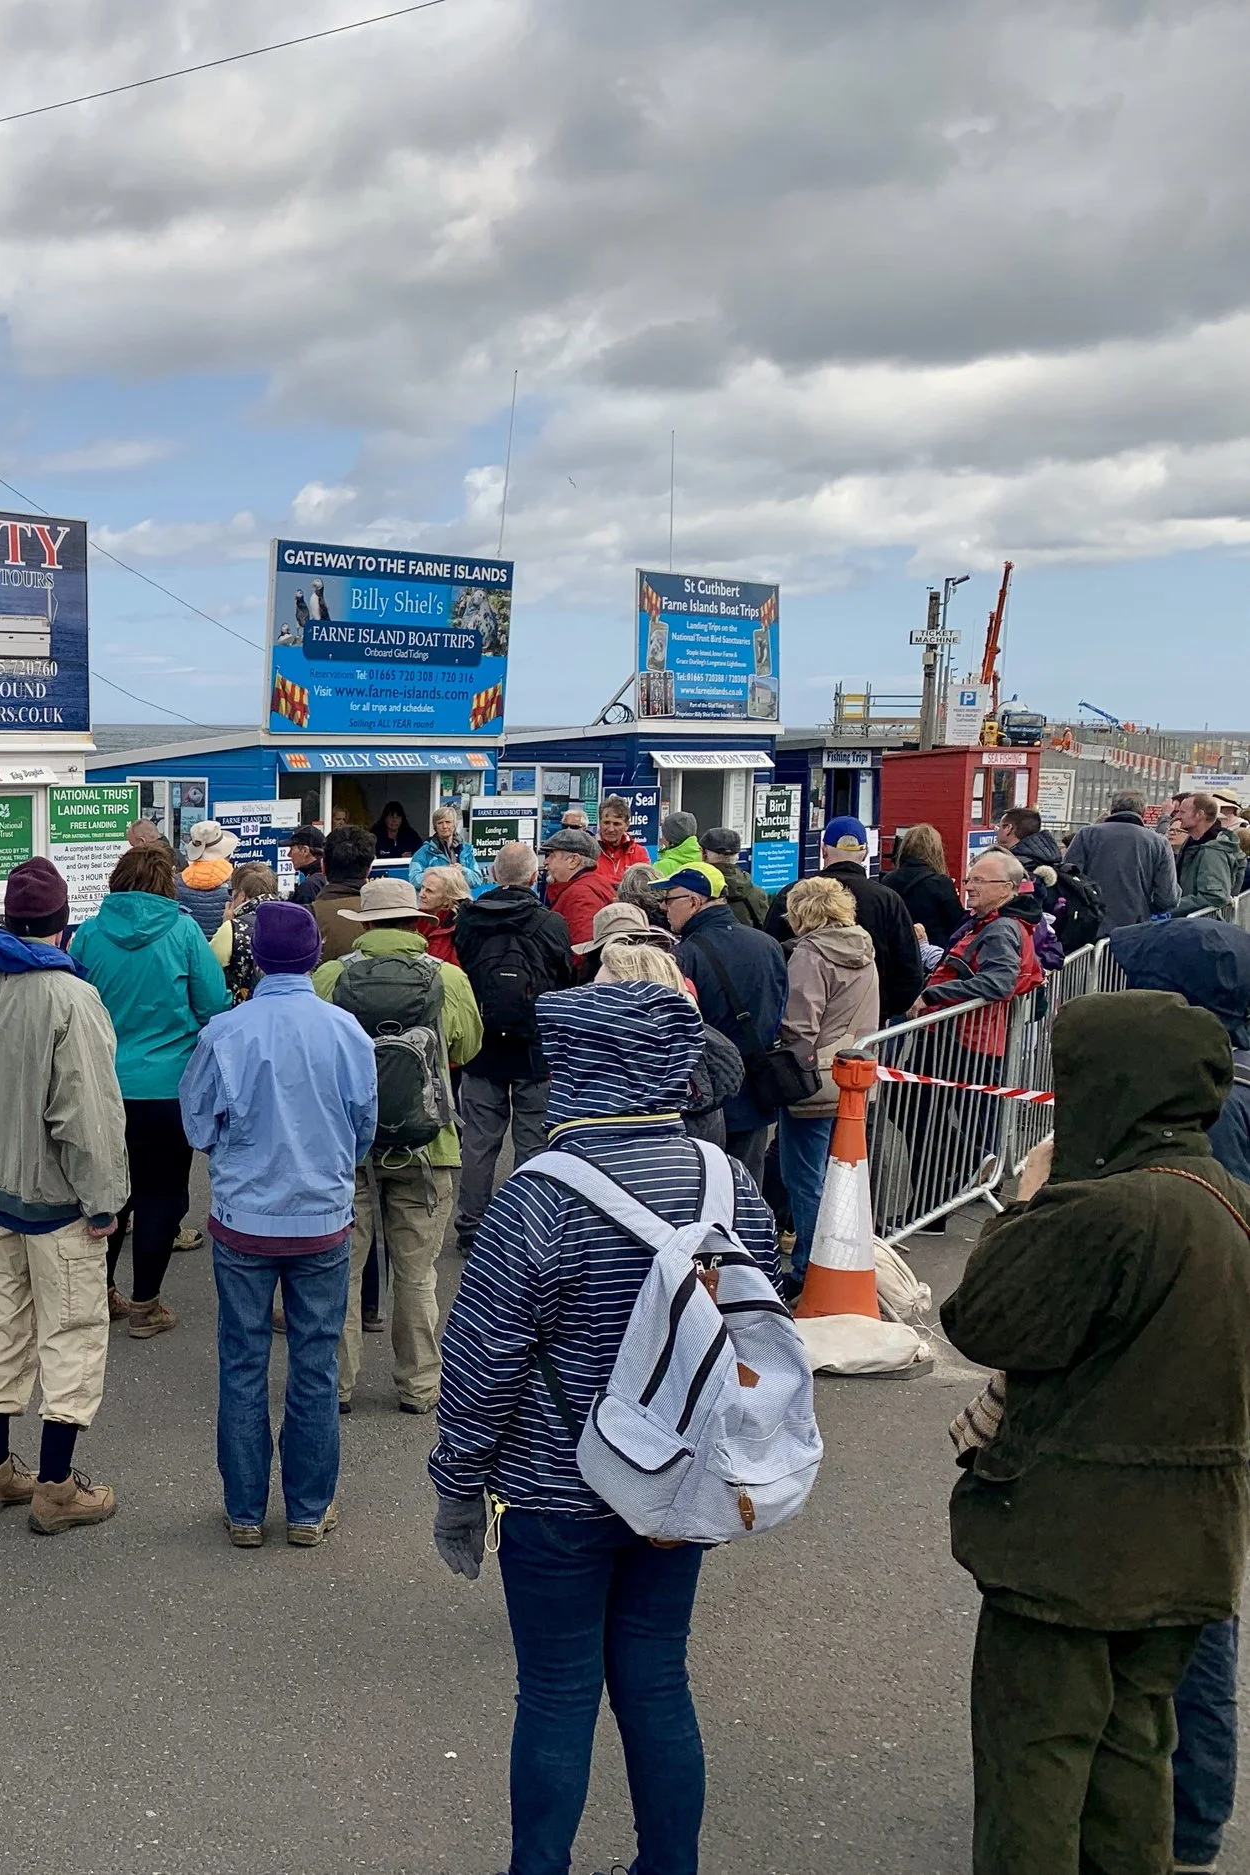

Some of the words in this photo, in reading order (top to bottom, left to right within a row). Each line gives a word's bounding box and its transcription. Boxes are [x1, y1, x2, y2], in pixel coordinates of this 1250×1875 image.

[284, 550, 355, 568] GATEWAY
[357, 556, 377, 571] TO
[378, 558, 405, 573] THE
[408, 561, 450, 578] FARNE
[454, 564, 508, 582] ISLANDS
[0, 568, 54, 589] TOURS
[684, 578, 695, 593] St
[698, 580, 740, 598] Cuthbert
[351, 588, 389, 617] Billy
[395, 591, 443, 615] Shiel's
[662, 597, 688, 611] Farne
[689, 599, 718, 614] Islands
[720, 602, 739, 616] Boat
[740, 604, 759, 620] Trips
[312, 626, 355, 643] FARNE
[358, 628, 405, 645] ISLAND
[408, 631, 441, 647] BOAT
[443, 633, 475, 648] TRIPS
[710, 634, 721, 643] Bird
[365, 647, 393, 658] Onboard
[394, 648, 408, 658] Glad
[408, 649, 429, 661] Tidings
[10, 659, 58, 677] 720760
[368, 669, 396, 681] 01665
[399, 670, 415, 681] 720
[418, 671, 433, 682] 308
[441, 672, 456, 683] 720
[459, 672, 474, 683] 316
[313, 685, 332, 697] Visit
[335, 684, 469, 701] www.farne-islands.com
[963, 692, 974, 705] P
[350, 701, 360, 711] for
[362, 702, 370, 711] all
[372, 702, 387, 713] trips
[388, 702, 401, 712] and
[377, 719, 391, 728] ALL
[393, 719, 411, 728] YEAR
[413, 719, 434, 728] round
[319, 753, 374, 767] BILLY
[375, 753, 429, 767] SHIEL
[674, 754, 717, 764] CUTHBERT
[717, 754, 741, 764] BOAT
[740, 754, 766, 764] TRIPS
[827, 751, 850, 765] Fishing
[852, 751, 868, 765] Trips
[987, 753, 999, 763] SEA
[999, 753, 1022, 764] FISHING
[24, 768, 44, 780] Douglas
[53, 790, 101, 801] NATIONAL
[102, 789, 134, 800] TRUST
[635, 792, 656, 806] Seal
[57, 805, 100, 816] LANDING
[102, 803, 130, 815] TRIPS
[769, 799, 787, 813] Bird
[0, 820, 23, 830] National
[70, 821, 87, 830] FREE
[88, 820, 117, 830] LANDING
[222, 816, 240, 825] FARNE
[0, 829, 14, 838] Trust
[242, 824, 259, 834] 10-30
[761, 830, 781, 840] Landing
[237, 838, 252, 847] Seal
[253, 837, 277, 846] Cruise
[476, 838, 501, 846] National
[252, 849, 264, 857] ALL
[280, 862, 293, 872] 1-30
[85, 873, 104, 881] HOUR
[71, 893, 88, 901] FARNE
